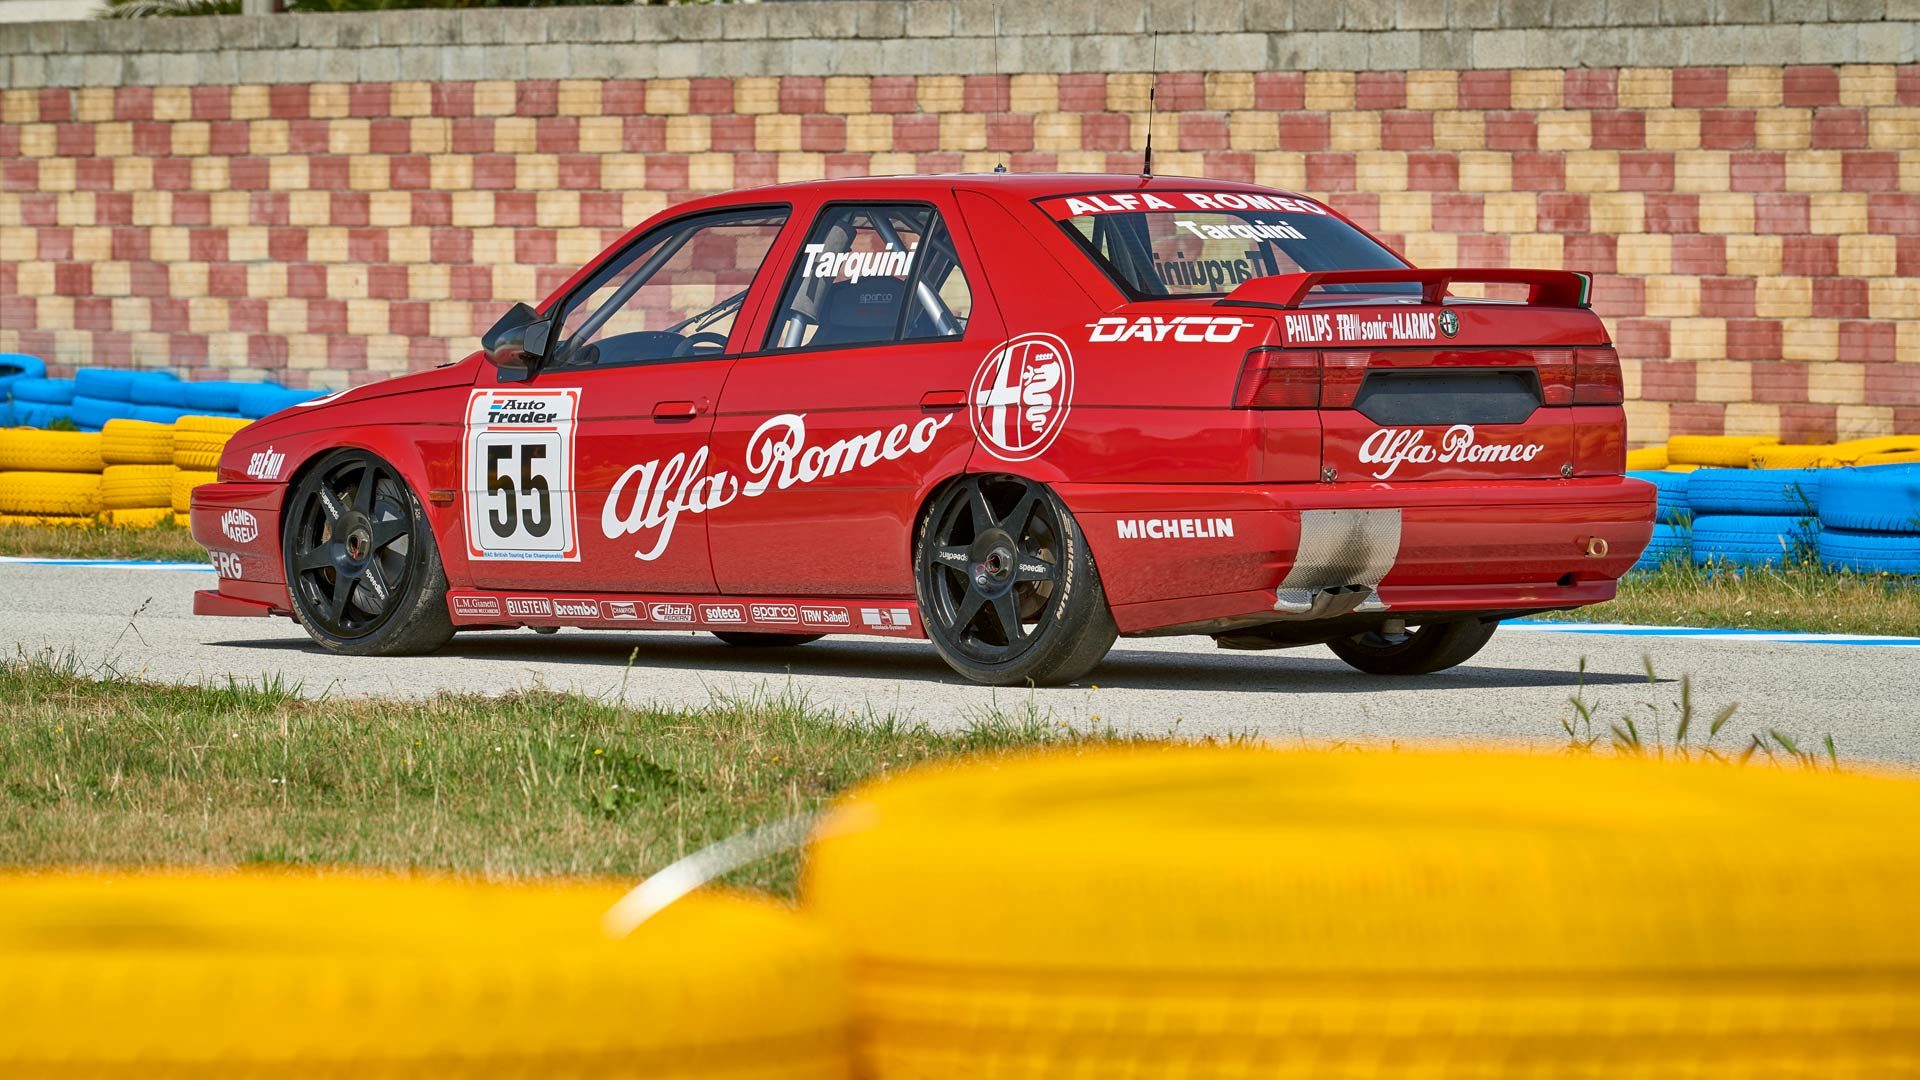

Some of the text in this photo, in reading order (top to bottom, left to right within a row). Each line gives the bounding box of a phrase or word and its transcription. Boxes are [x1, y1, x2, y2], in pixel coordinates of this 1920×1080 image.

[1065, 193, 1327, 216] ALFA ROMEO
[1174, 220, 1308, 243] Tarquini
[802, 242, 919, 284] Tarquini
[859, 293, 893, 303] sparco
[1085, 316, 1254, 343] DAYCO
[1285, 313, 1333, 342] PHILIPS
[1392, 312, 1436, 340] ALARMS
[502, 399, 546, 410] Auto
[487, 411, 557, 423] Trader
[1358, 424, 1544, 480] Alfa Romeo
[487, 444, 552, 538] 55
[601, 413, 953, 561] Alfa Romeo
[1116, 518, 1234, 539] MICHELIN
[1057, 538, 1074, 621] MICHELIN
[506, 600, 551, 614] BILSTEIN
[553, 602, 598, 616] brembo
[612, 606, 636, 615] CHAMPION
[652, 604, 692, 621] Eibach
[706, 606, 740, 619] soteco
[752, 605, 796, 620] sparco
[802, 609, 848, 623] TRW Sabelt
